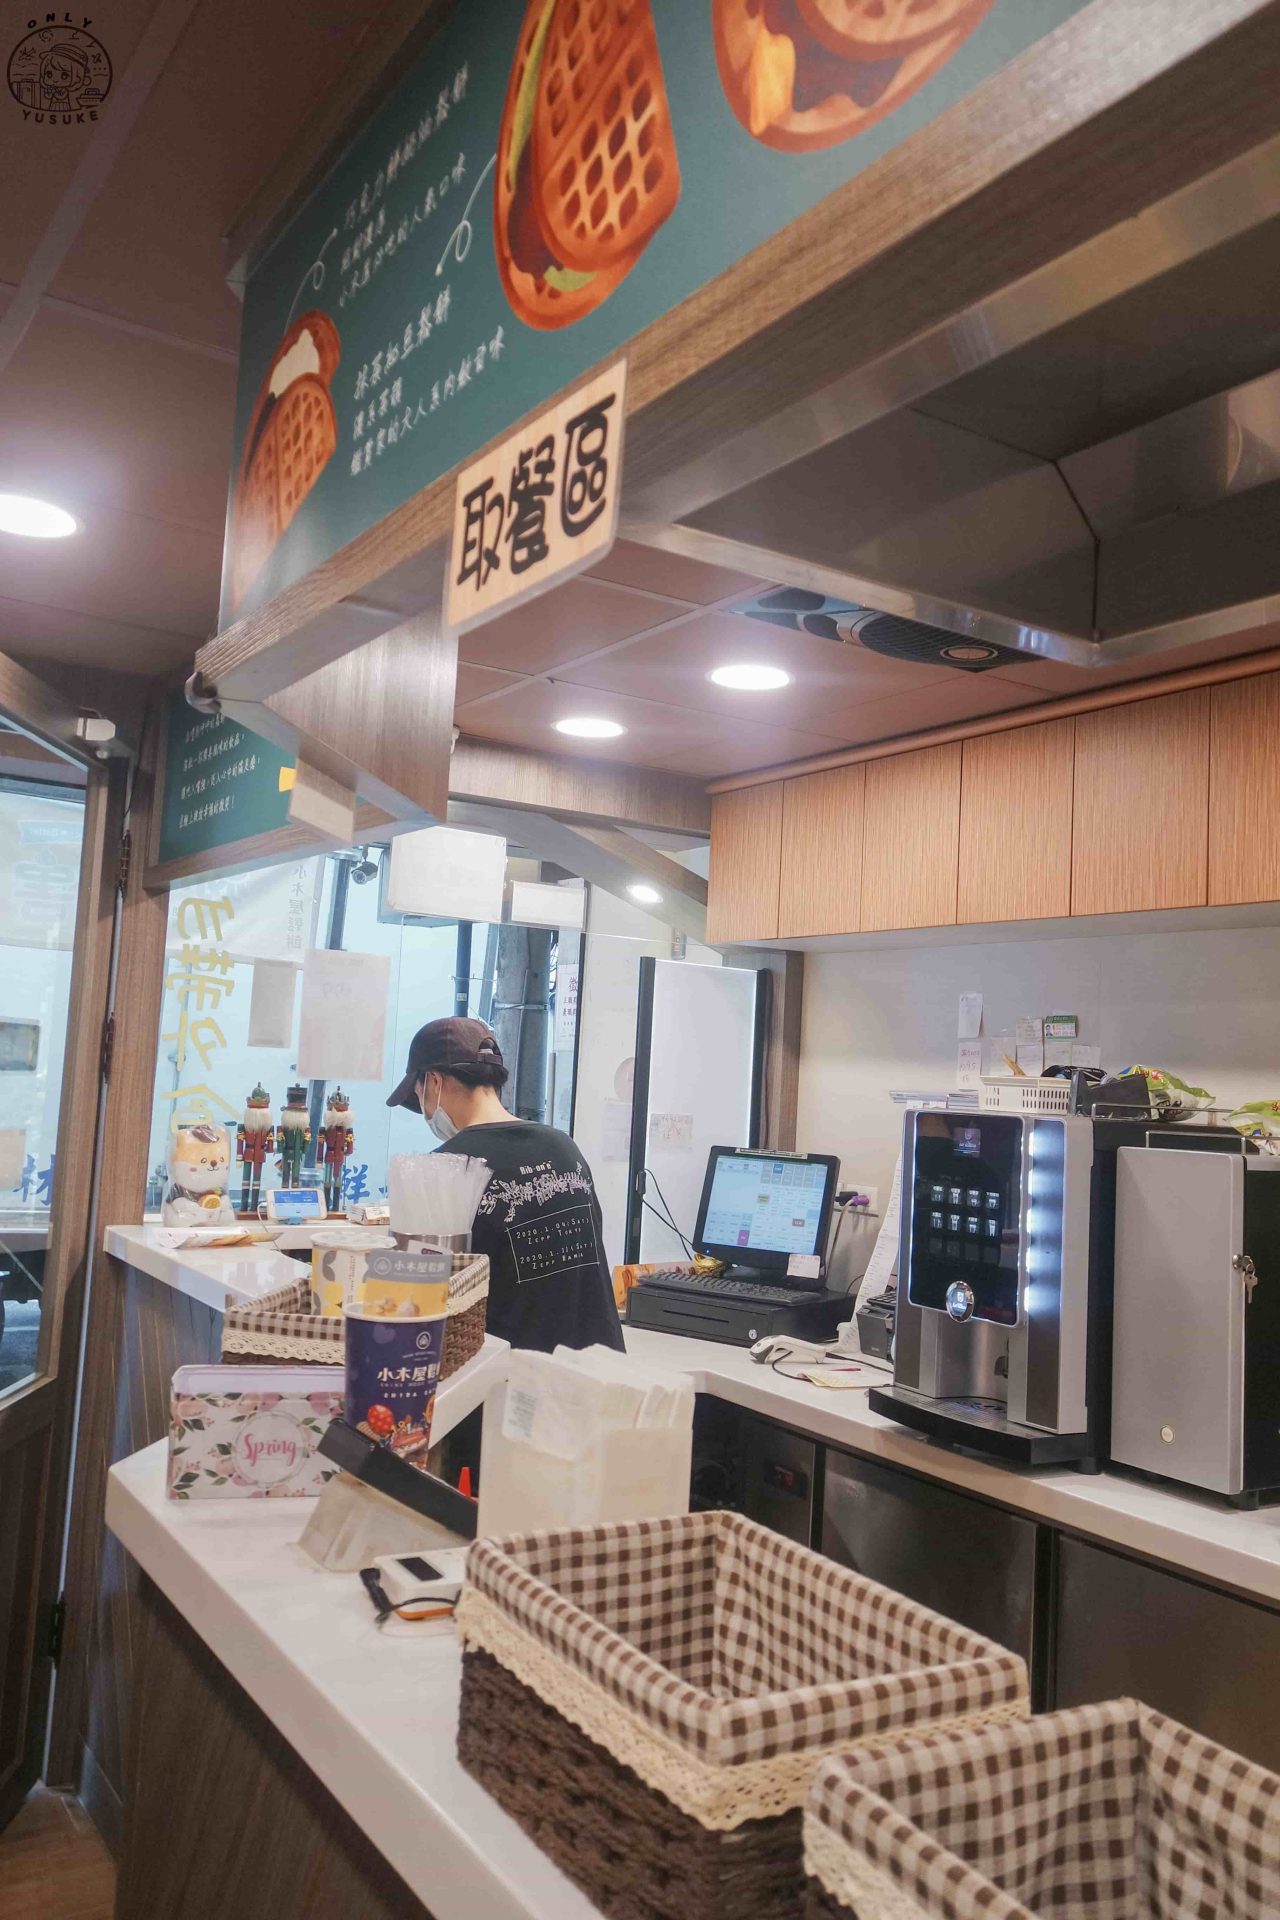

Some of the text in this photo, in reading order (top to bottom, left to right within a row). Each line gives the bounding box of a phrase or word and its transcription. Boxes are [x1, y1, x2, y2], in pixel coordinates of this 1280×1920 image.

[456, 392, 617, 592] 取餐區
[243, 1433, 297, 1468] Spring
